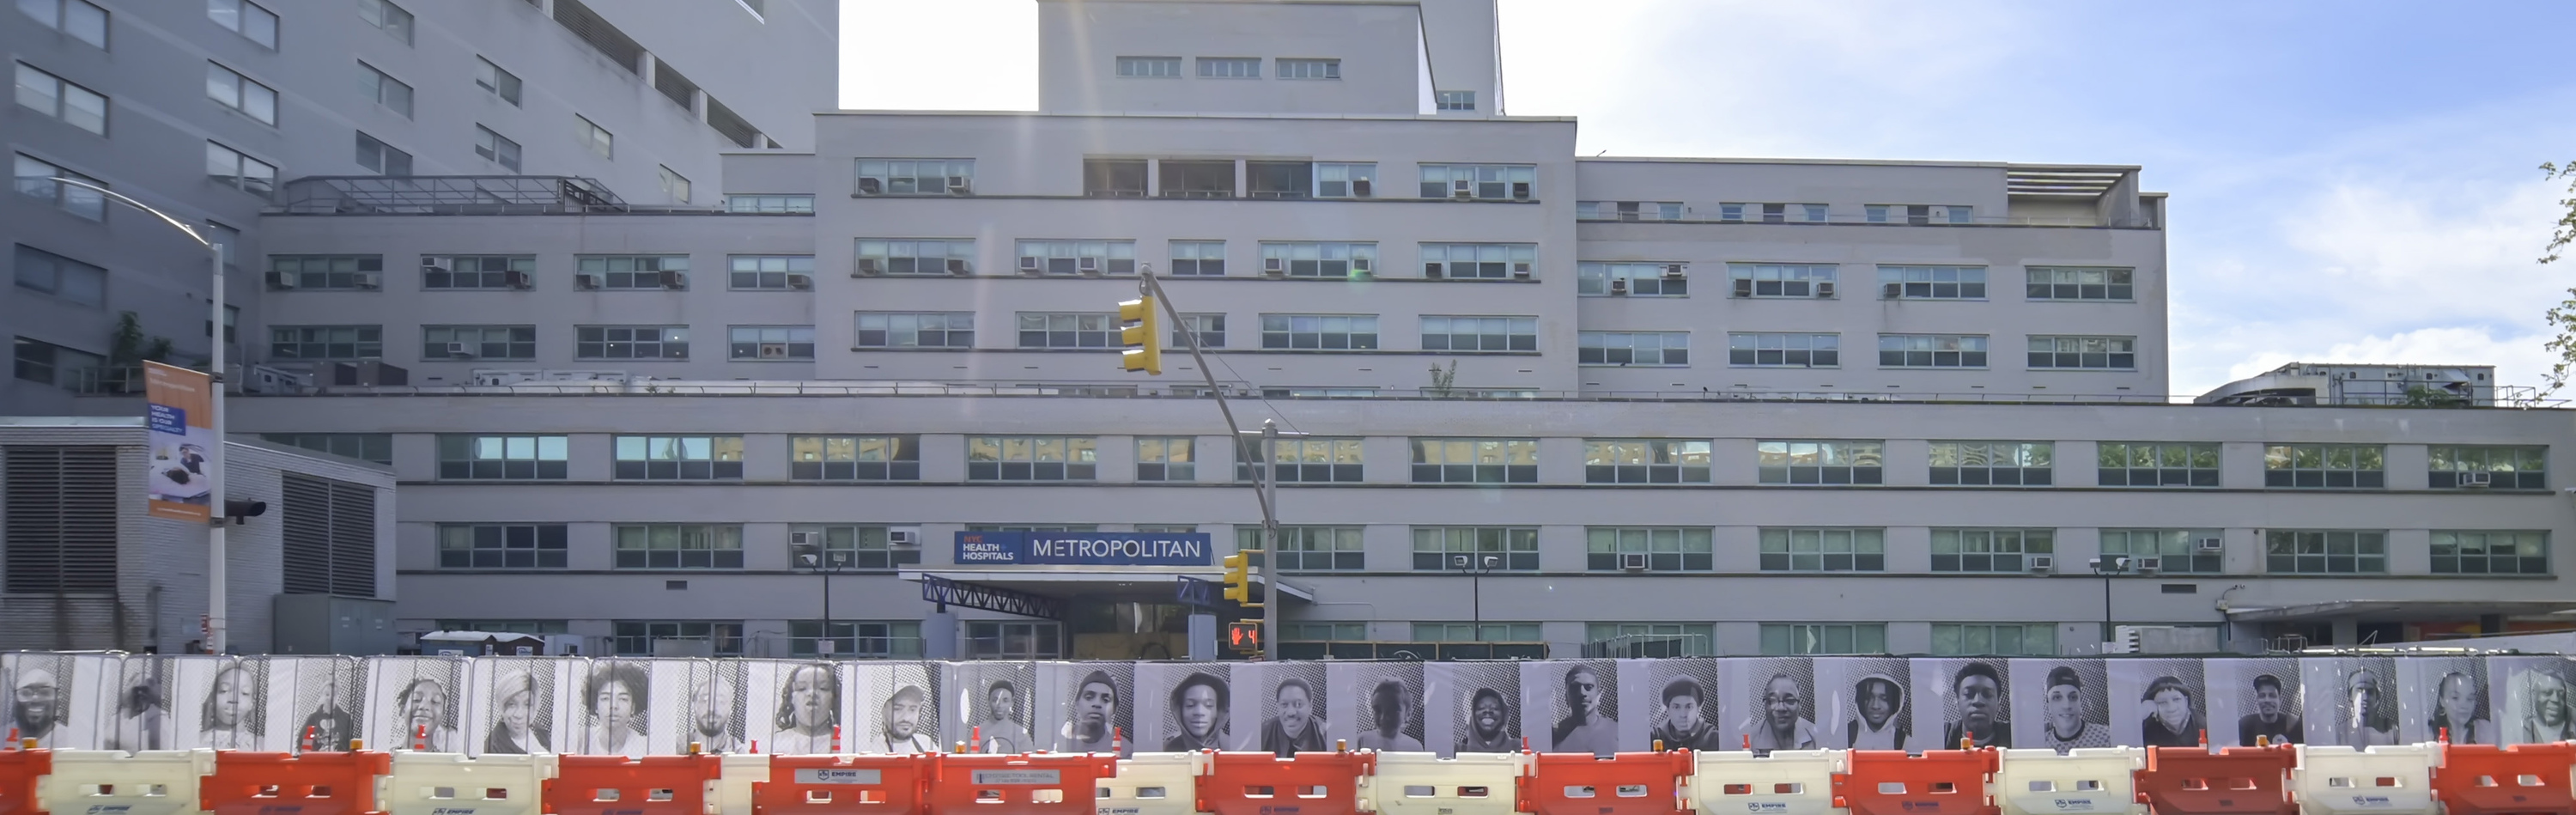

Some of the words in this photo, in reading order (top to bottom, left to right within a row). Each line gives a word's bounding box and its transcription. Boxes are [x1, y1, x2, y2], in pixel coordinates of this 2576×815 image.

[151, 411, 175, 420] HEALTH
[1033, 539, 1200, 557] METROPOLITAN
[1248, 629, 1256, 644] 4
